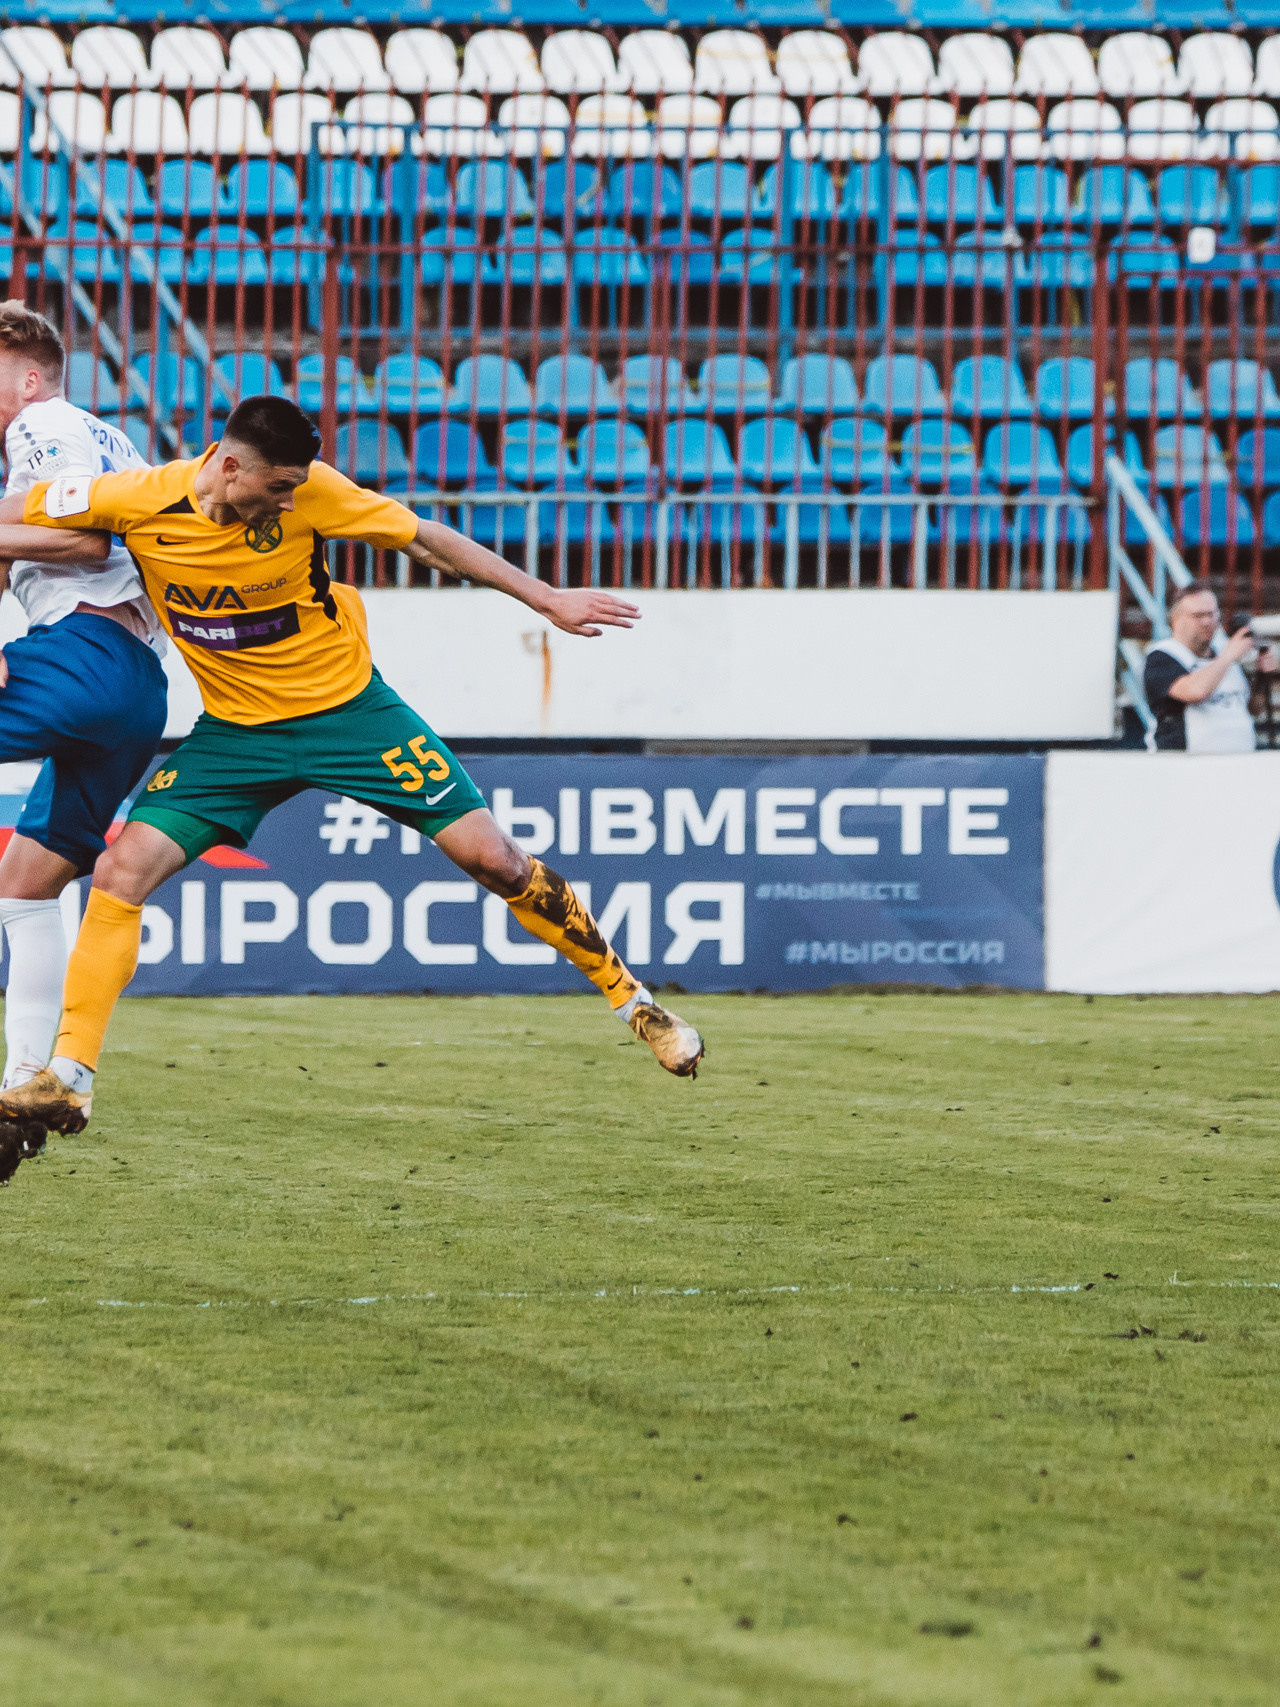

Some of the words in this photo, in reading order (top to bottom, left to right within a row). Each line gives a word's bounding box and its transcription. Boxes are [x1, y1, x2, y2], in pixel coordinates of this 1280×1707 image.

[164, 583, 247, 612] AVA
[241, 577, 287, 594] GROUP
[177, 616, 285, 641] PARIBET
[381, 734, 451, 792] 55
[319, 787, 1010, 855] #ЫВМЕСТЕ
[755, 881, 920, 901] #МЫВМЕСТЕ
[784, 940, 1007, 965] #МЫРОССИЯ
